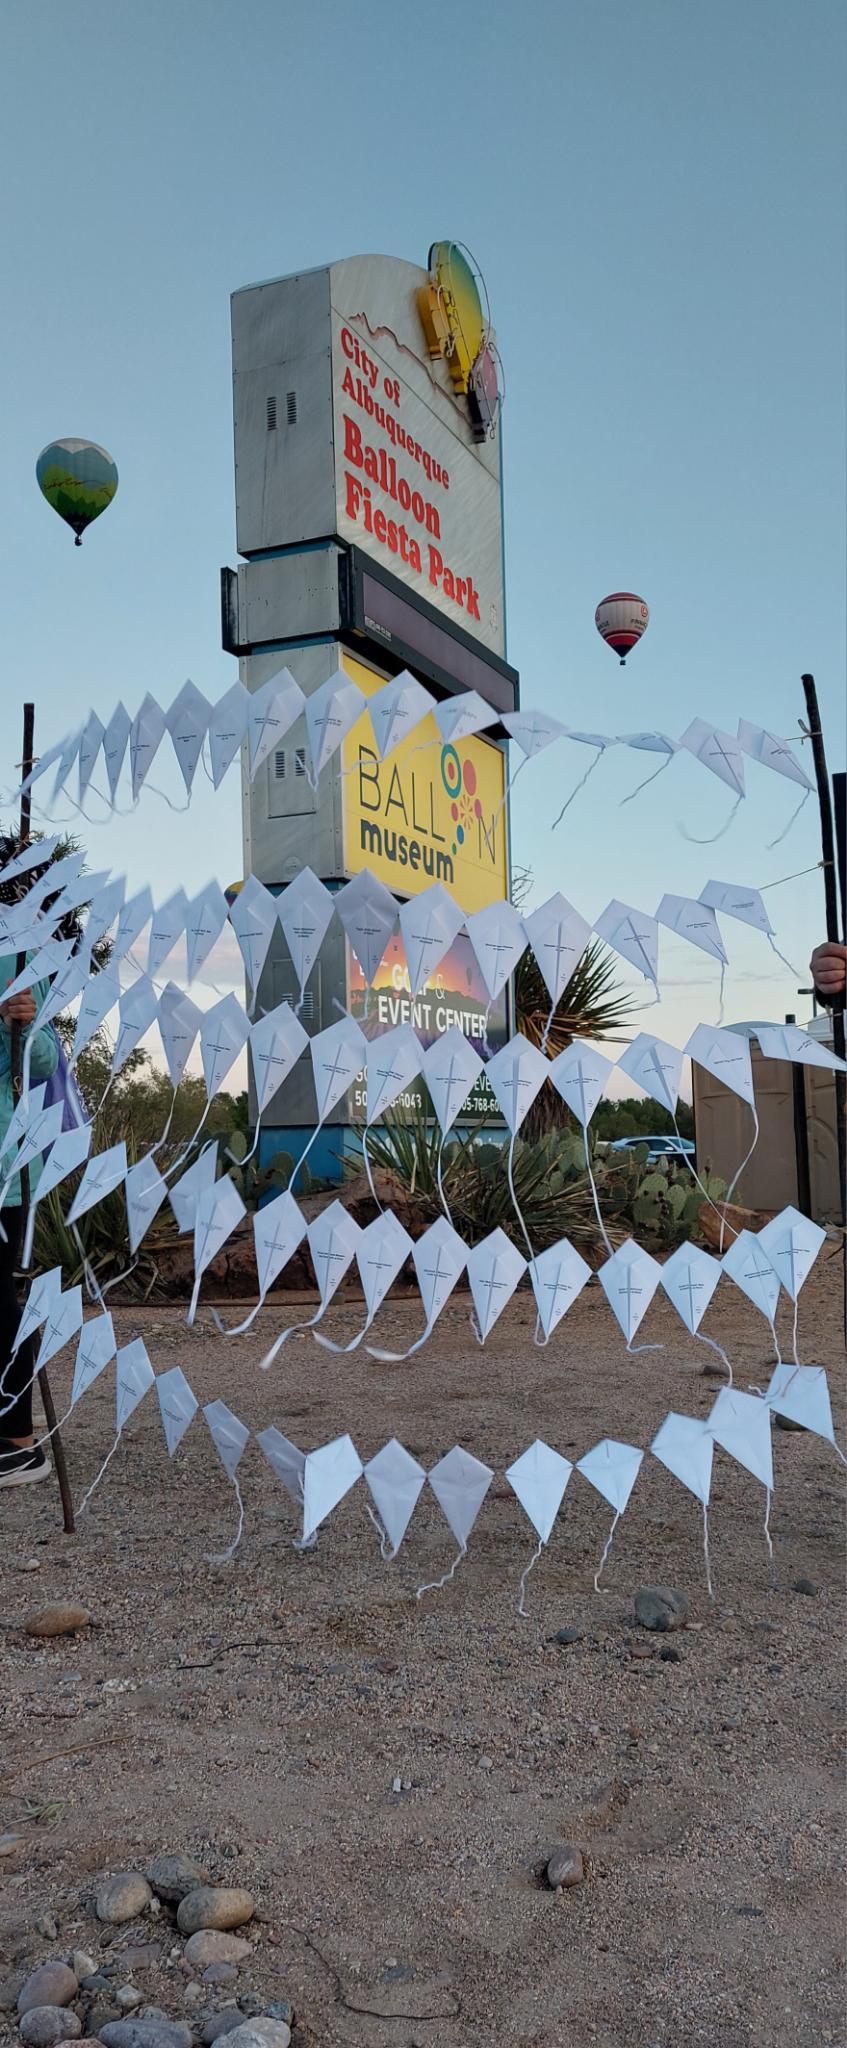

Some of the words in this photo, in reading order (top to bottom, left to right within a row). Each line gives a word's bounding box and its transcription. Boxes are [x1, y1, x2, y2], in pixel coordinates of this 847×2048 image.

[341, 328, 378, 385] City
[384, 379, 400, 407] of
[342, 367, 449, 490] Albuquerque
[342, 413, 442, 539] Balloon
[344, 470, 422, 575] Fiesta
[428, 544, 482, 621] Park
[361, 818, 454, 884] museum
[378, 995, 431, 1030] EVENT
[436, 1006, 487, 1038] CENTER
